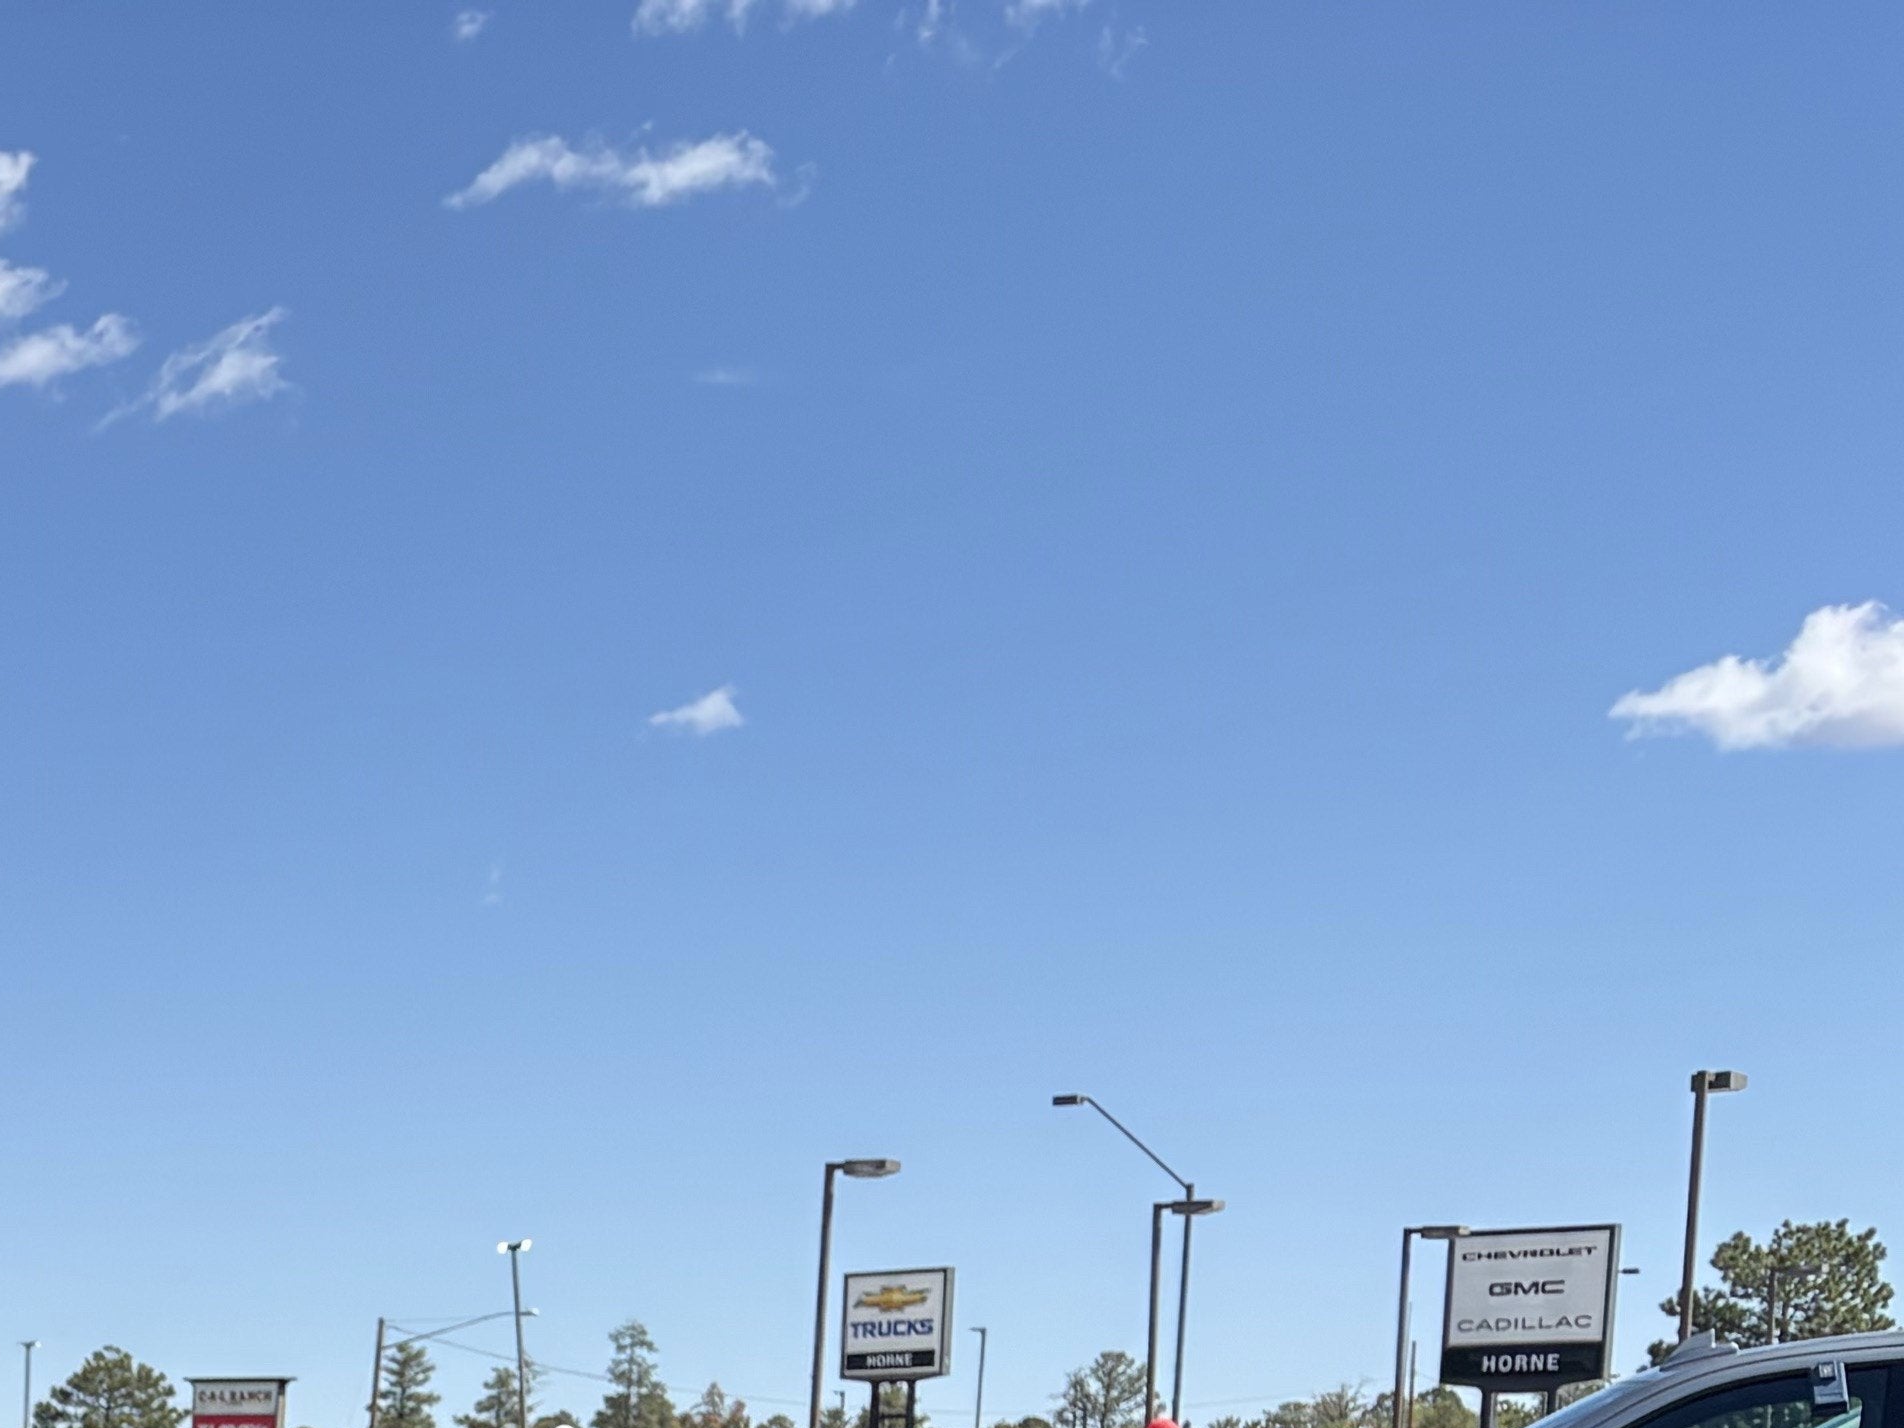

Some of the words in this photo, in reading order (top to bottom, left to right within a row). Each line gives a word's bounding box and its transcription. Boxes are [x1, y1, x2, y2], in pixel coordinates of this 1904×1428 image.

[1461, 1245, 1597, 1262] CHEVROLET
[1488, 1279, 1566, 1297] GMC
[850, 1318, 934, 1339] TRUCKS
[1456, 1314, 1593, 1333] CADILLAC
[865, 1352, 913, 1368] HORNE
[1480, 1353, 1560, 1374] HORNE
